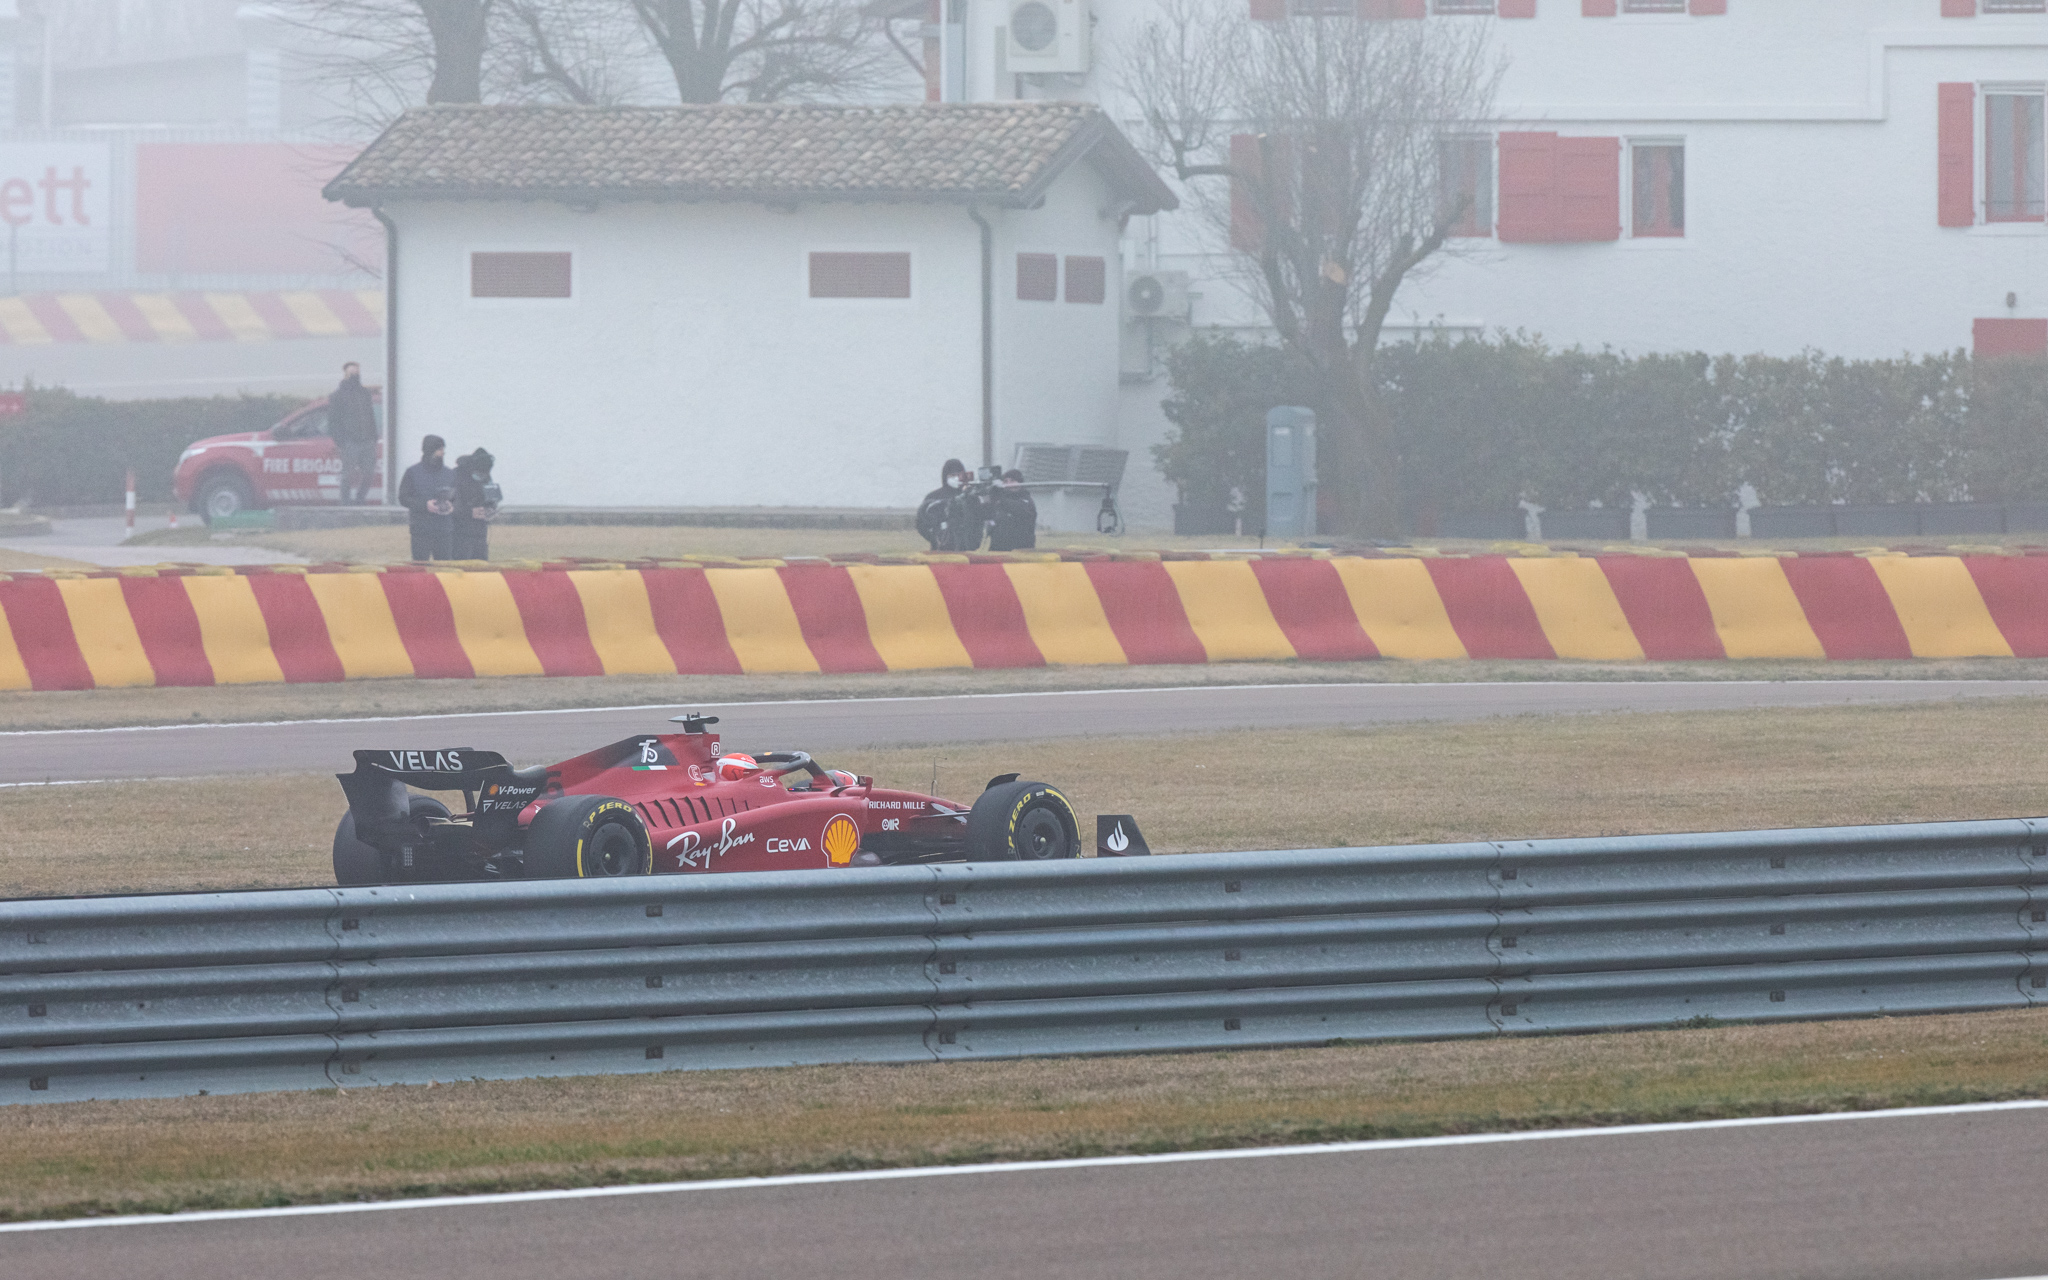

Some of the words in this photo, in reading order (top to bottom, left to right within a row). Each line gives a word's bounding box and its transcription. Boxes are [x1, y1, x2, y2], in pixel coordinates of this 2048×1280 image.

[263, 458, 290, 473] FIRE
[293, 458, 343, 473] BRIGAD
[389, 751, 463, 771] VELAS
[759, 775, 774, 783] aws
[498, 786, 536, 795] V-Power
[494, 800, 527, 810] VELAS
[868, 801, 901, 809] RICHARD
[902, 801, 926, 810] MILLE
[589, 811, 596, 823] P
[598, 801, 632, 814] ZERO
[1008, 793, 1032, 833] ZERO
